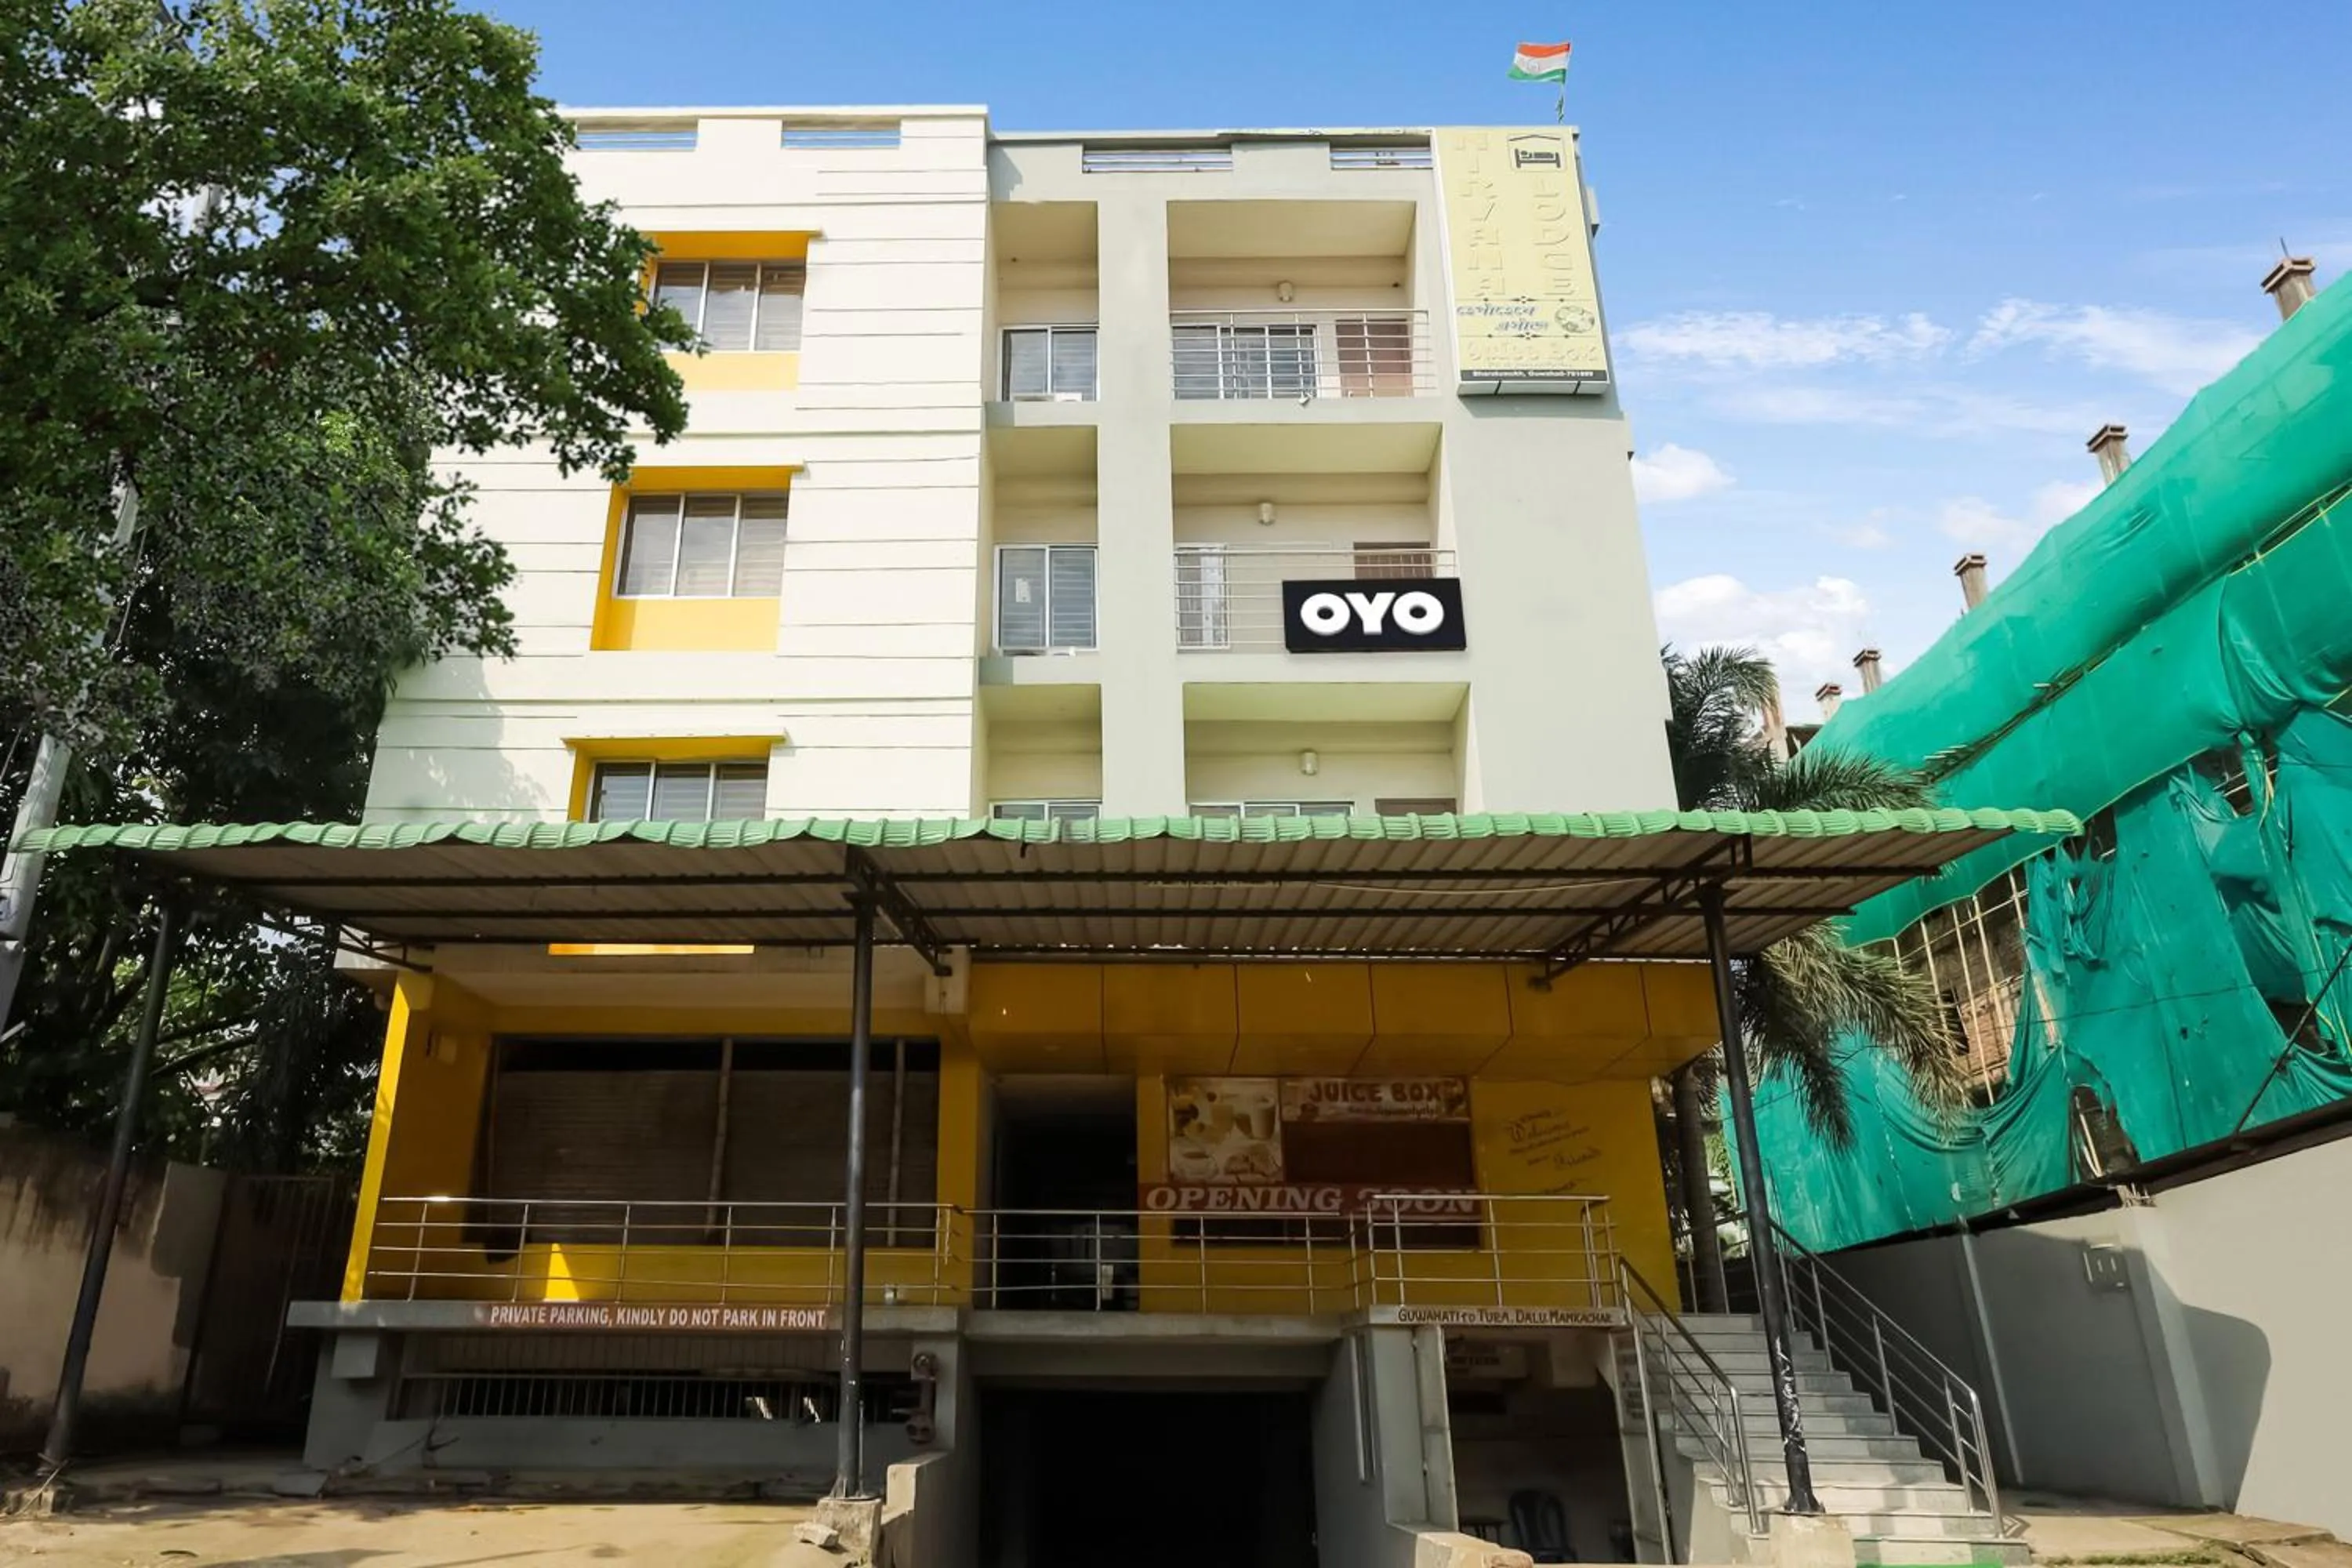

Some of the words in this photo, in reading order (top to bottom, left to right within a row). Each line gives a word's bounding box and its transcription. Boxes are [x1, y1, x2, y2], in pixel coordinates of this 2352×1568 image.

[1300, 591, 1445, 636] OYO
[1308, 1081, 1382, 1102] JUICE
[1391, 1082, 1441, 1102] BOX
[1146, 1186, 1342, 1211] OPENING
[1356, 1187, 1479, 1212] SOON
[490, 1306, 546, 1323] PRIVATE
[550, 1307, 612, 1327] PARKING,
[615, 1308, 666, 1326] KINDLY
[669, 1309, 688, 1326] DO
[691, 1309, 720, 1326] NOT
[723, 1309, 758, 1327] PARK
[761, 1310, 776, 1327] IN
[780, 1310, 826, 1327] FRONT
